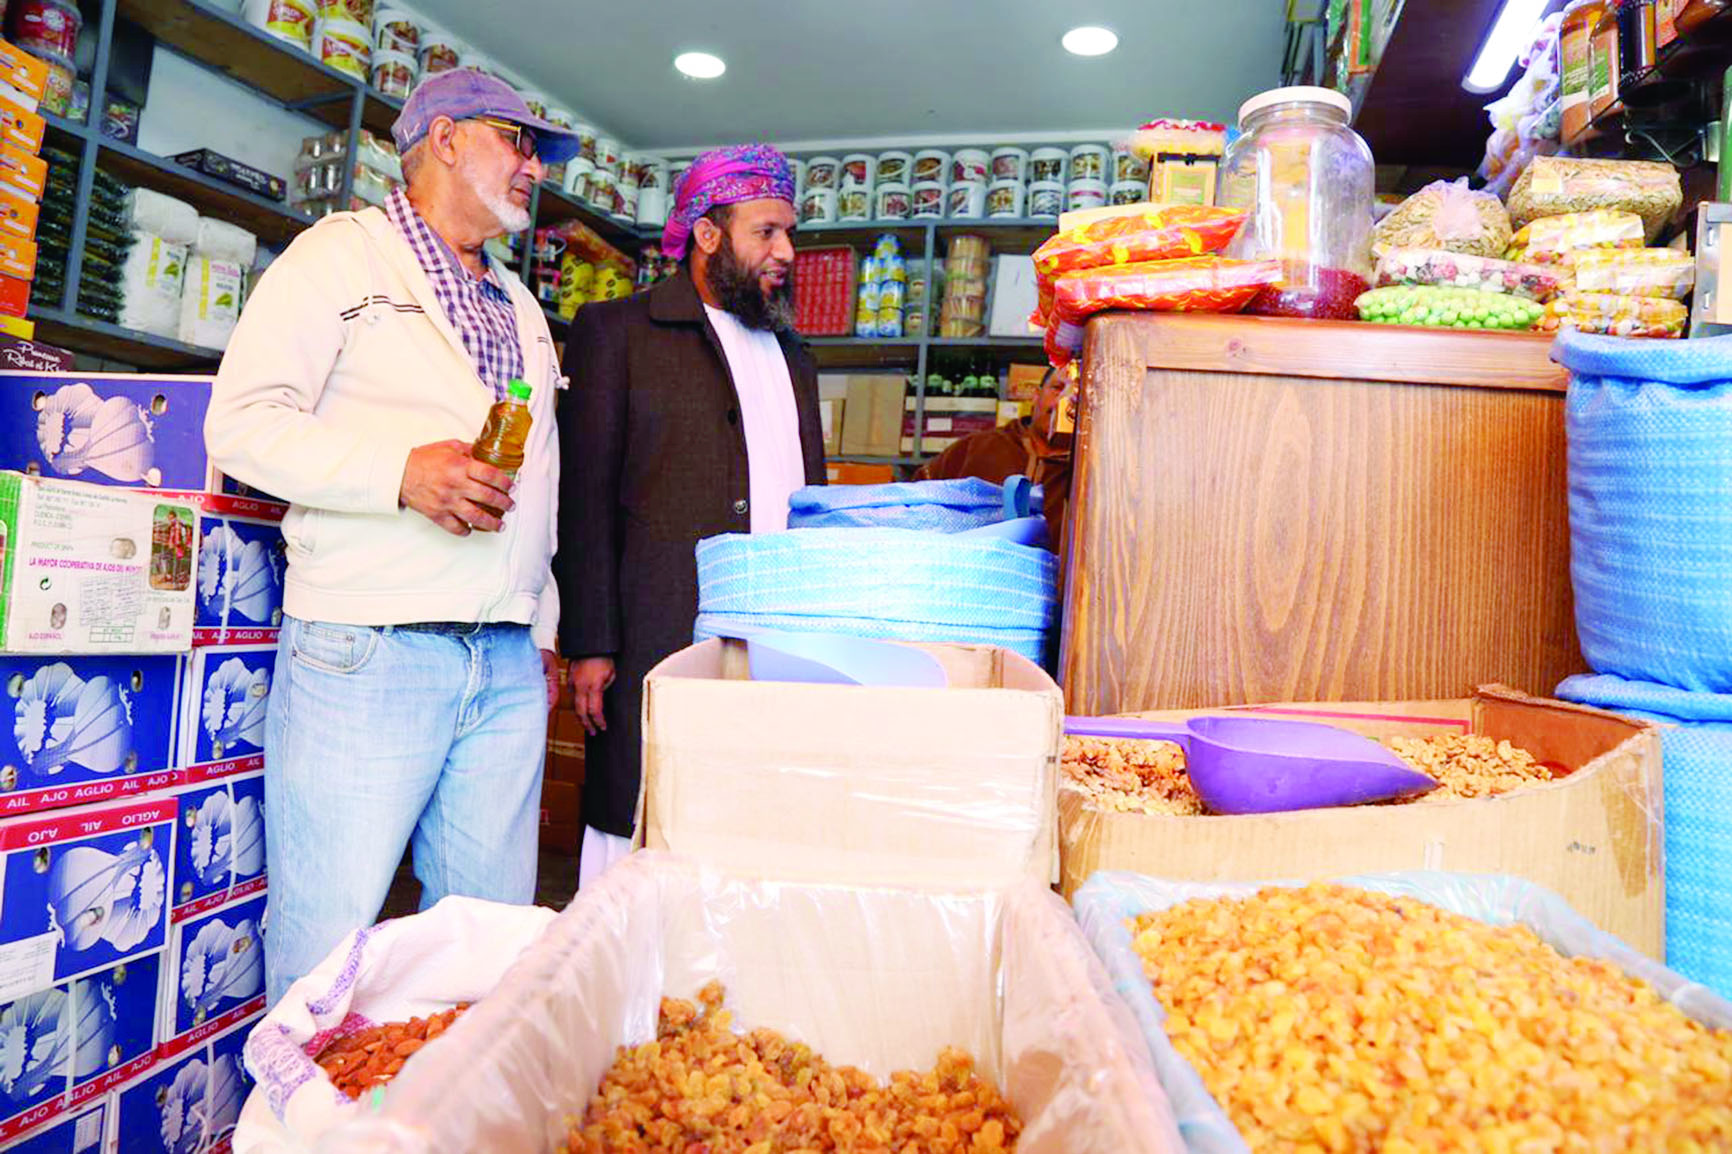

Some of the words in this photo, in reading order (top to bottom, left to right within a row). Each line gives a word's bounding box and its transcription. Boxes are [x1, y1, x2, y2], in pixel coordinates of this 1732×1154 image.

[29, 557, 36, 566] LA
[38, 557, 58, 567] MAYOR
[59, 559, 94, 569] COOPERATIVA
[235, 631, 263, 639] AGLIO
[206, 762, 236, 775] AGLIO
[7, 797, 30, 809] AIL
[41, 790, 68, 803] AJO
[74, 783, 114, 798] AGLIO
[121, 780, 140, 791] AIL
[148, 775, 168, 786] AJO
[122, 809, 160, 825] AGLIO
[81, 820, 102, 832] AIL
[28, 827, 58, 842] AJO
[187, 1021, 219, 1043] AGLIO
[19, 1106, 48, 1128] AJO
[104, 1069, 123, 1086] AIL
[131, 1054, 152, 1073] AJO
